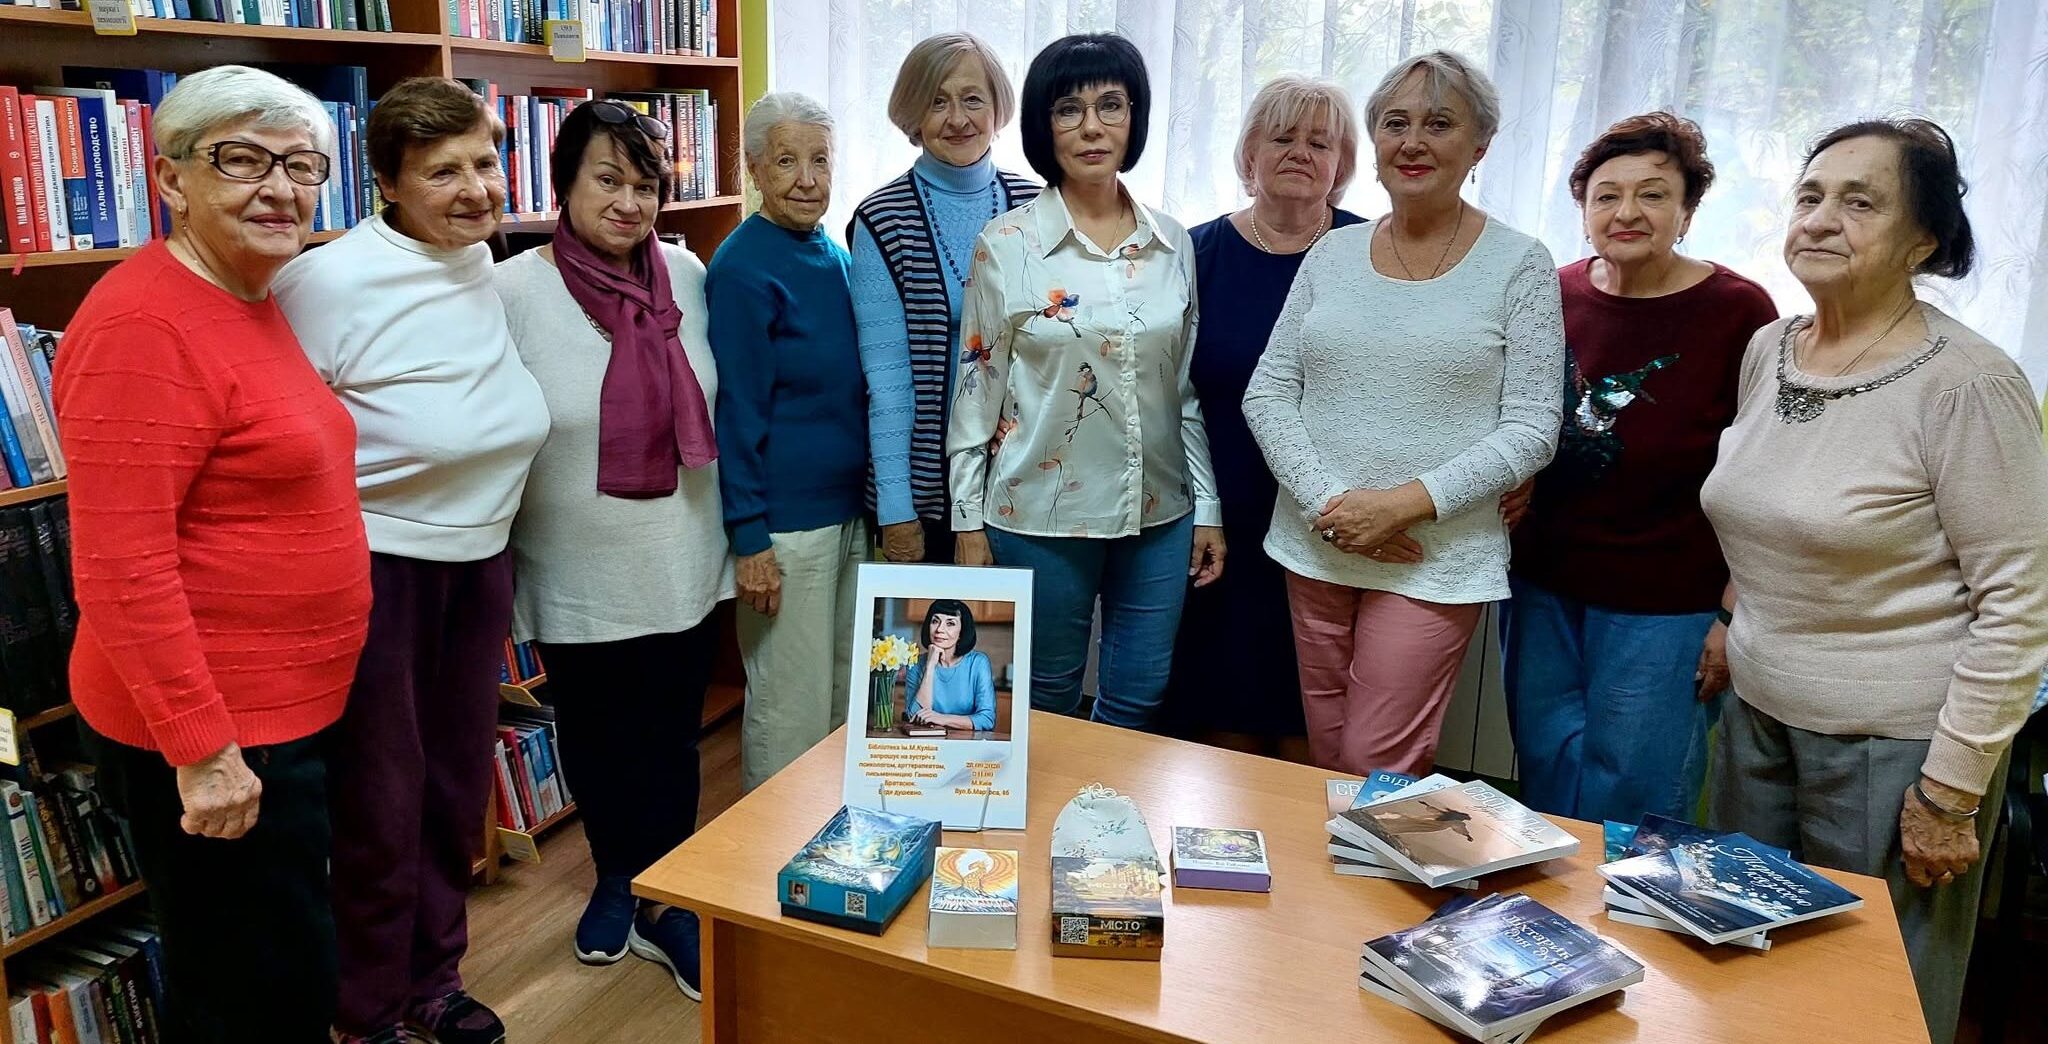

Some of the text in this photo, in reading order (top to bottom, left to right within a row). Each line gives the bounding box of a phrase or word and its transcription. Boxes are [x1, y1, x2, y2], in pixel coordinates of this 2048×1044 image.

[45, 115, 53, 142] ПРАКТИКА
[65, 99, 79, 174] Основи менеджменту
[130, 127, 143, 177] МЕНЕДЖМЕНТ
[25, 108, 48, 223] МАРКЕТИНГОВИЙ МЕНЕДЖМЕНТ
[89, 117, 108, 221] ЗАГАЛЬНЕ ДІЛОВОДСТВО
[1463, 786, 1549, 834] СВОБОДА
[1715, 844, 1812, 895] Терапія
[1742, 871, 1813, 907] казкою
[1100, 919, 1141, 931] МІСТО
[1504, 928, 1533, 948] для
